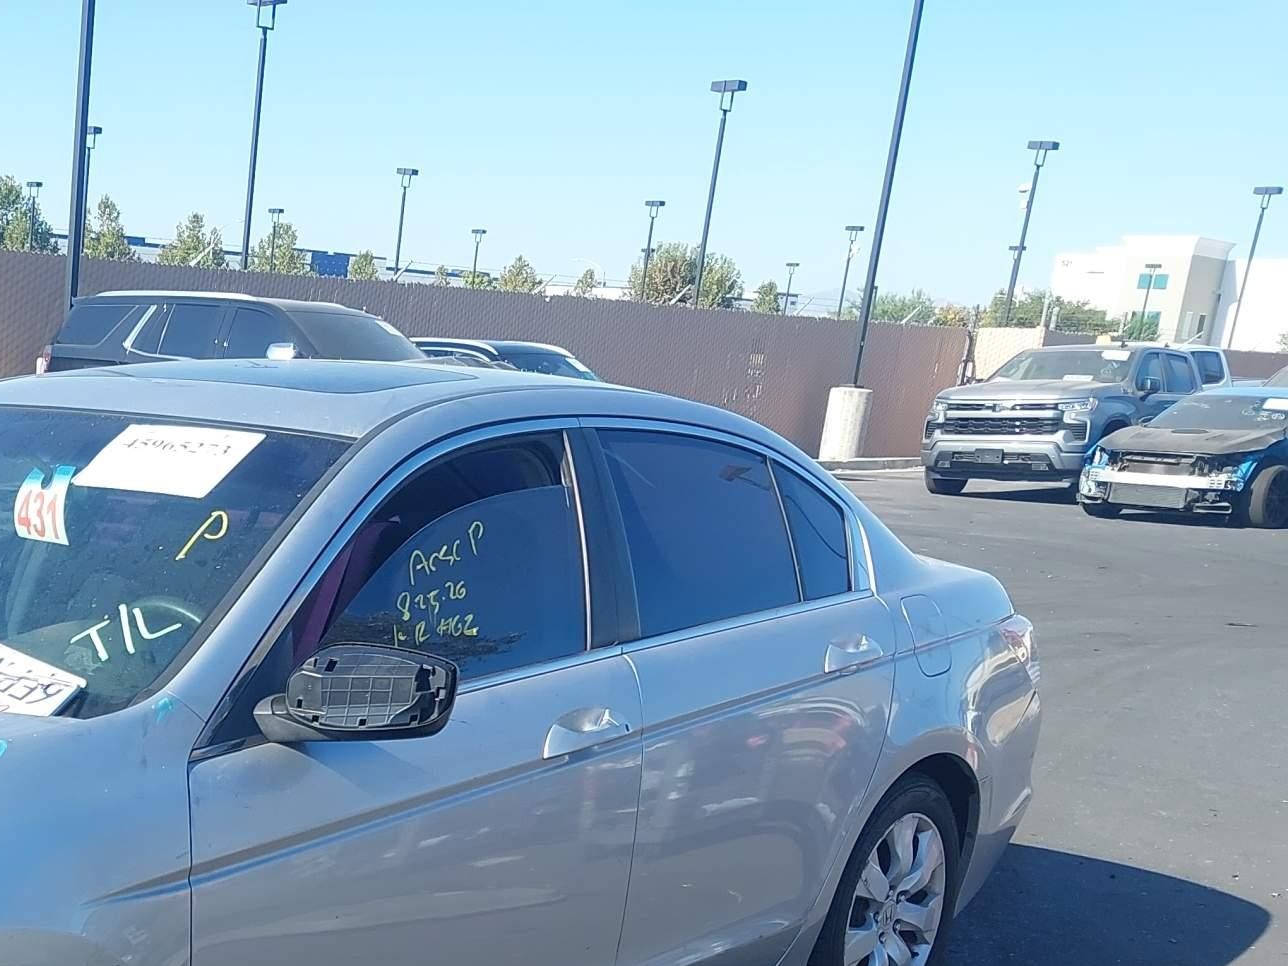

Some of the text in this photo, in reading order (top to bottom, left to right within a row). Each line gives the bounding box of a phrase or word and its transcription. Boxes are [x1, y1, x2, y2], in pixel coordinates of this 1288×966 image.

[17, 489, 61, 540] 431
[175, 510, 229, 561] P
[70, 603, 183, 662] T/L
